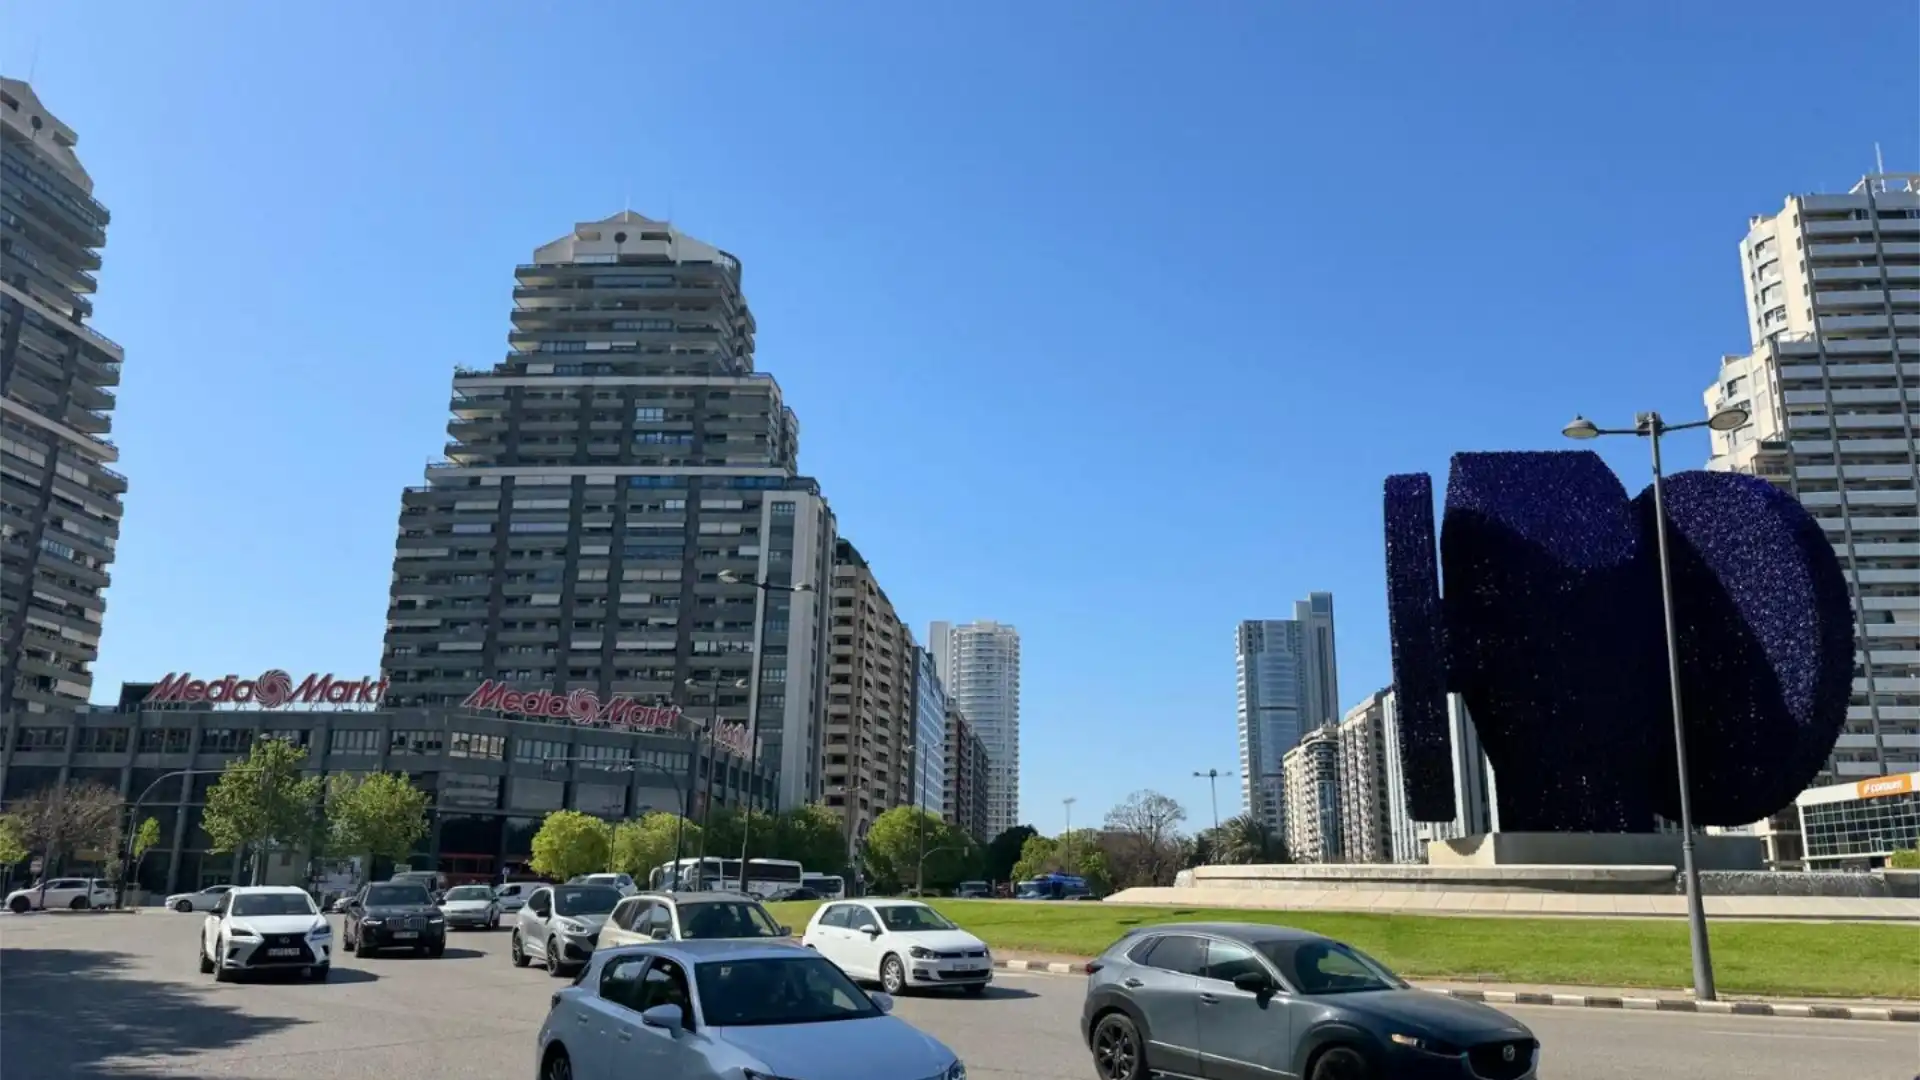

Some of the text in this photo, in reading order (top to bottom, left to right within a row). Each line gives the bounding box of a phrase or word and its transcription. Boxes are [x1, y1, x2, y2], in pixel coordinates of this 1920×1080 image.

[143, 672, 390, 703] Media Markt
[461, 678, 682, 729] Media Markt
